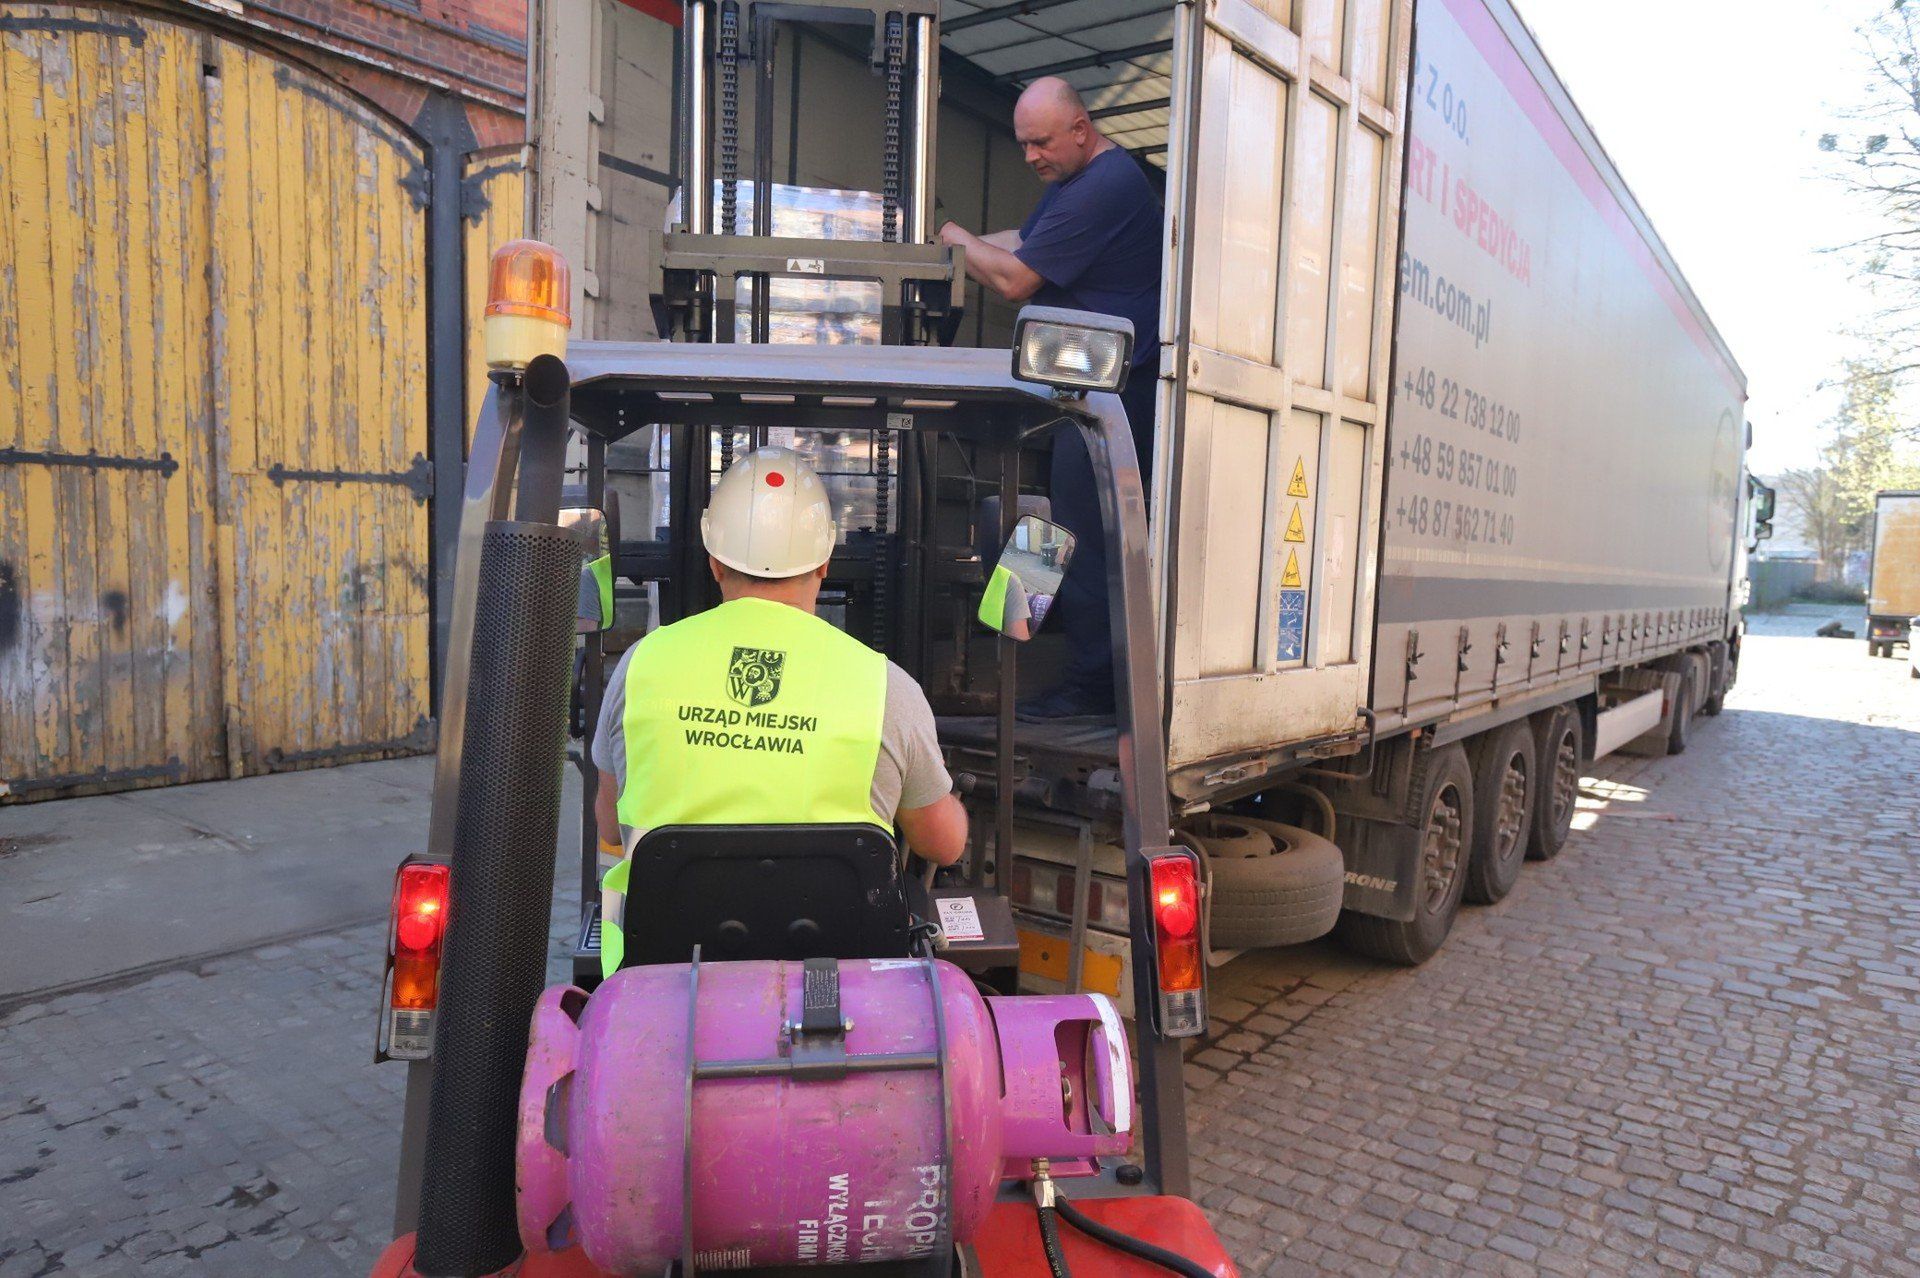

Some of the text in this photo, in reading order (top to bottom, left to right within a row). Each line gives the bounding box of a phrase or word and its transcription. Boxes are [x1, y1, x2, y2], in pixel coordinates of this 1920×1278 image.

[1426, 64, 1438, 111] Z
[1440, 164, 1450, 215] I
[1453, 178, 1532, 288] SPEDYCJA
[1404, 366, 1520, 444] +48 22 738 12 00
[1400, 433, 1516, 498] +48 59 857 01 00
[1397, 494, 1513, 546] +48 87 562 71 40
[678, 705, 741, 728] URZĄD
[745, 712, 817, 732] MIEJSKI
[685, 730, 804, 754] WROCŁAWIA
[797, 1219, 819, 1259] FIRMA
